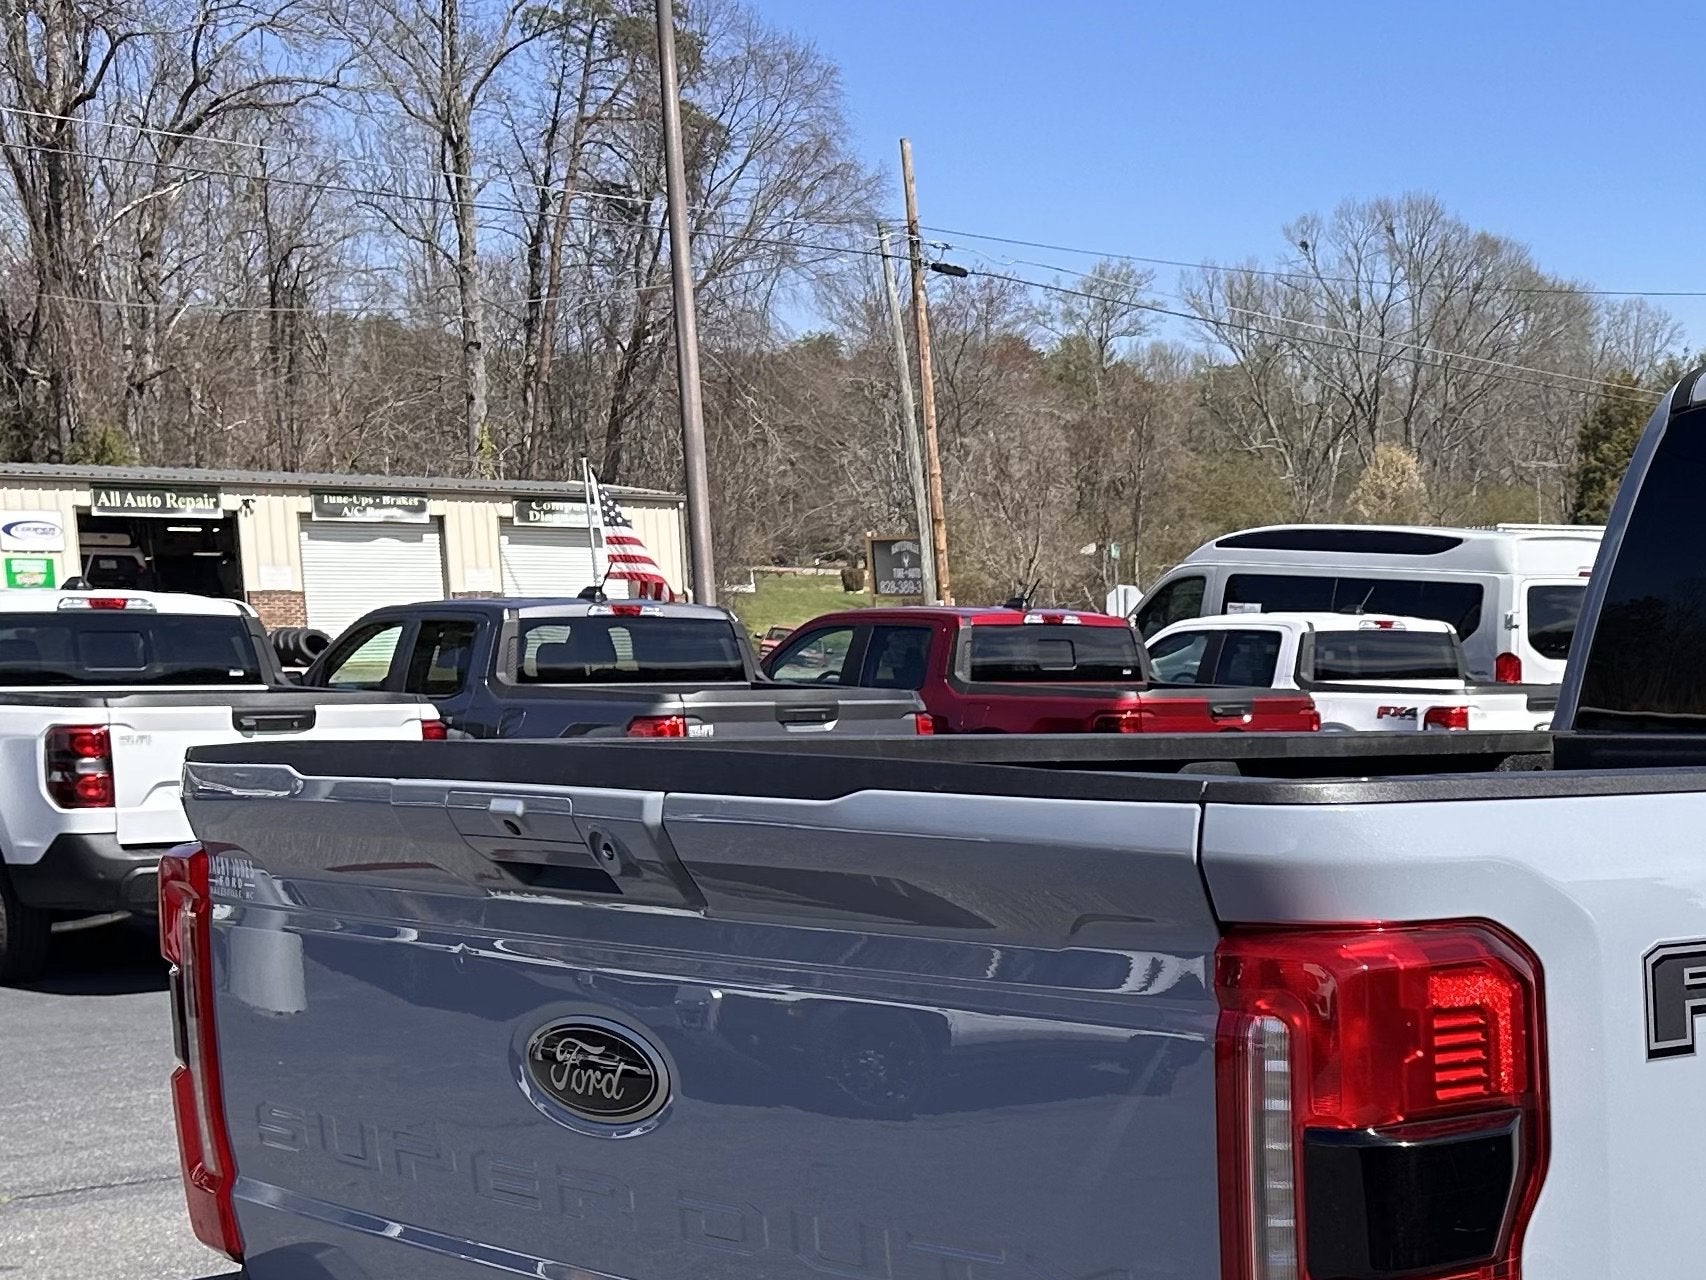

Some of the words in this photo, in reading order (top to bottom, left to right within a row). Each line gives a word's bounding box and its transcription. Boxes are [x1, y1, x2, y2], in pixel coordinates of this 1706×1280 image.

[97, 491, 120, 507] All
[124, 492, 162, 508] Auto
[165, 492, 216, 512] Repair
[550, 1037, 625, 1100] Ford
[256, 1102, 637, 1232] SUPER
